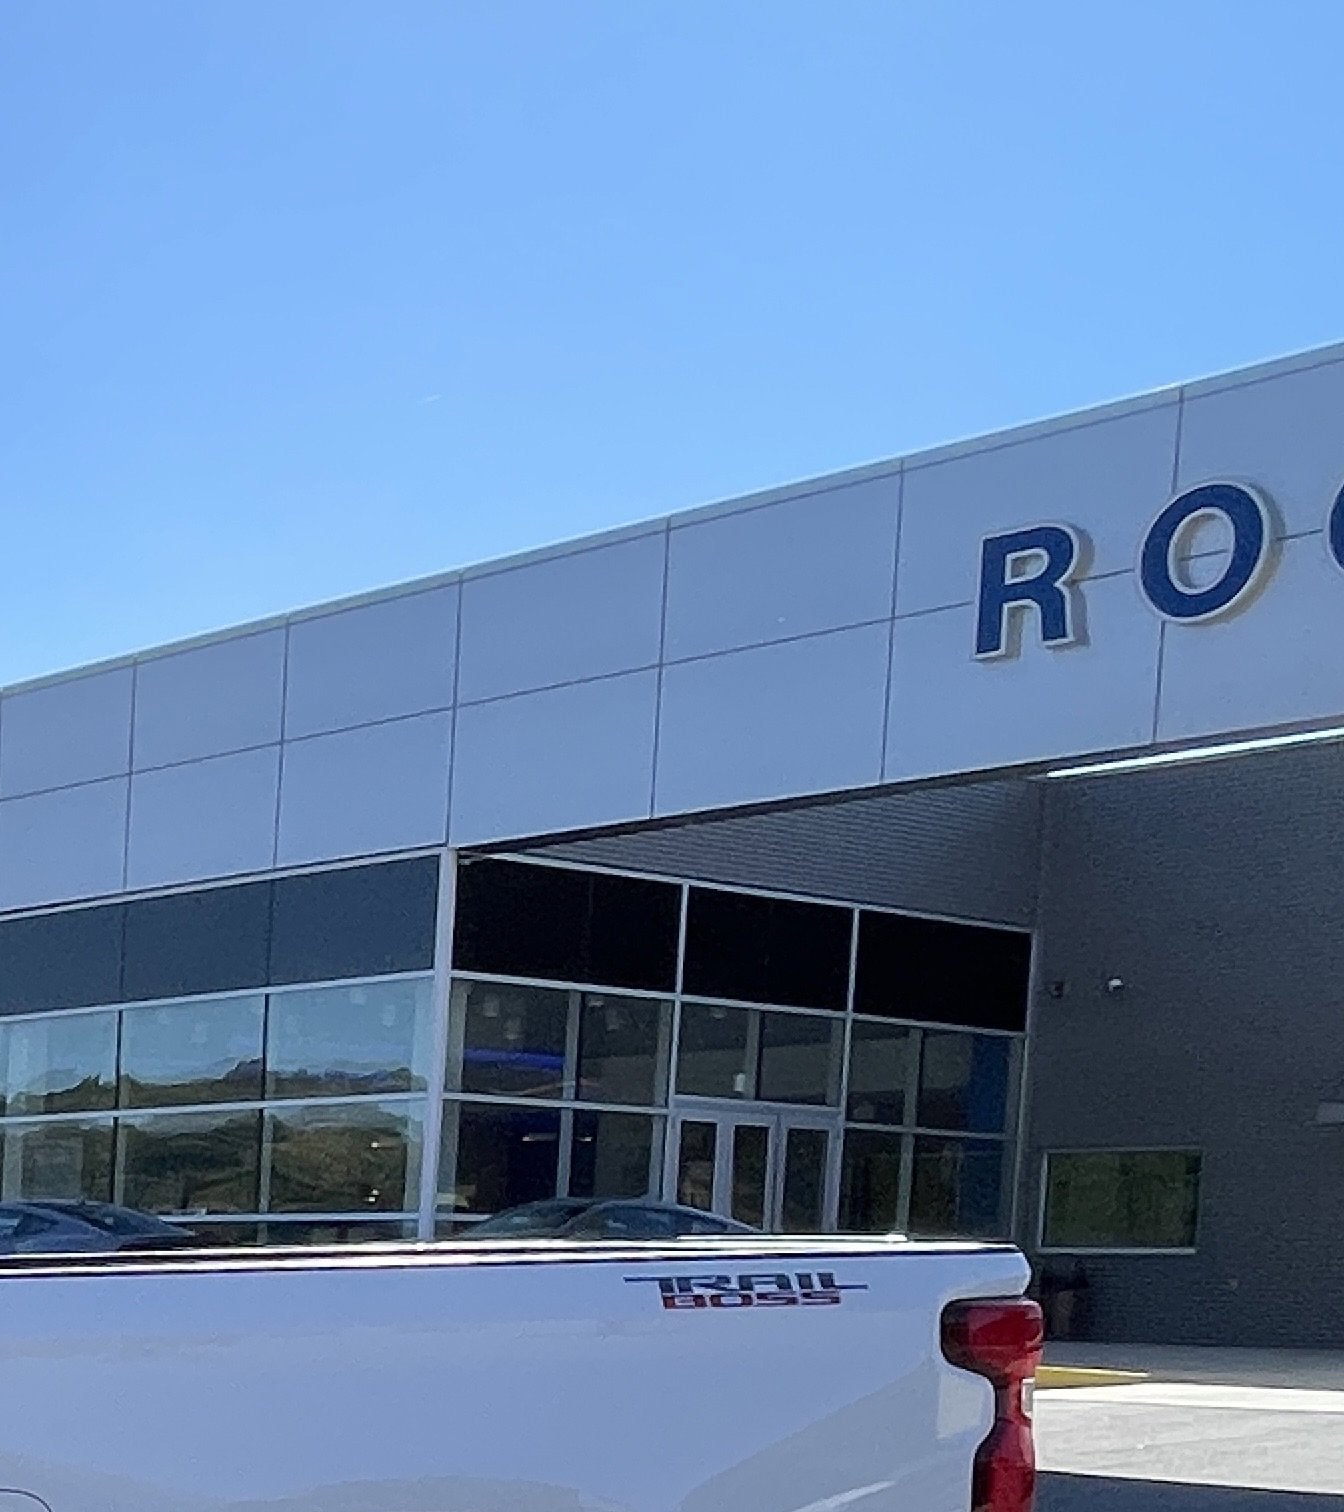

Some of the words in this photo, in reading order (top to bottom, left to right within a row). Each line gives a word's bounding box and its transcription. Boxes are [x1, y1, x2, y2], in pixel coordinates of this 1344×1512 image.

[972, 481, 1344, 660] RO
[623, 1272, 868, 1294] TRAIL
[662, 1289, 841, 1309] BOSS
